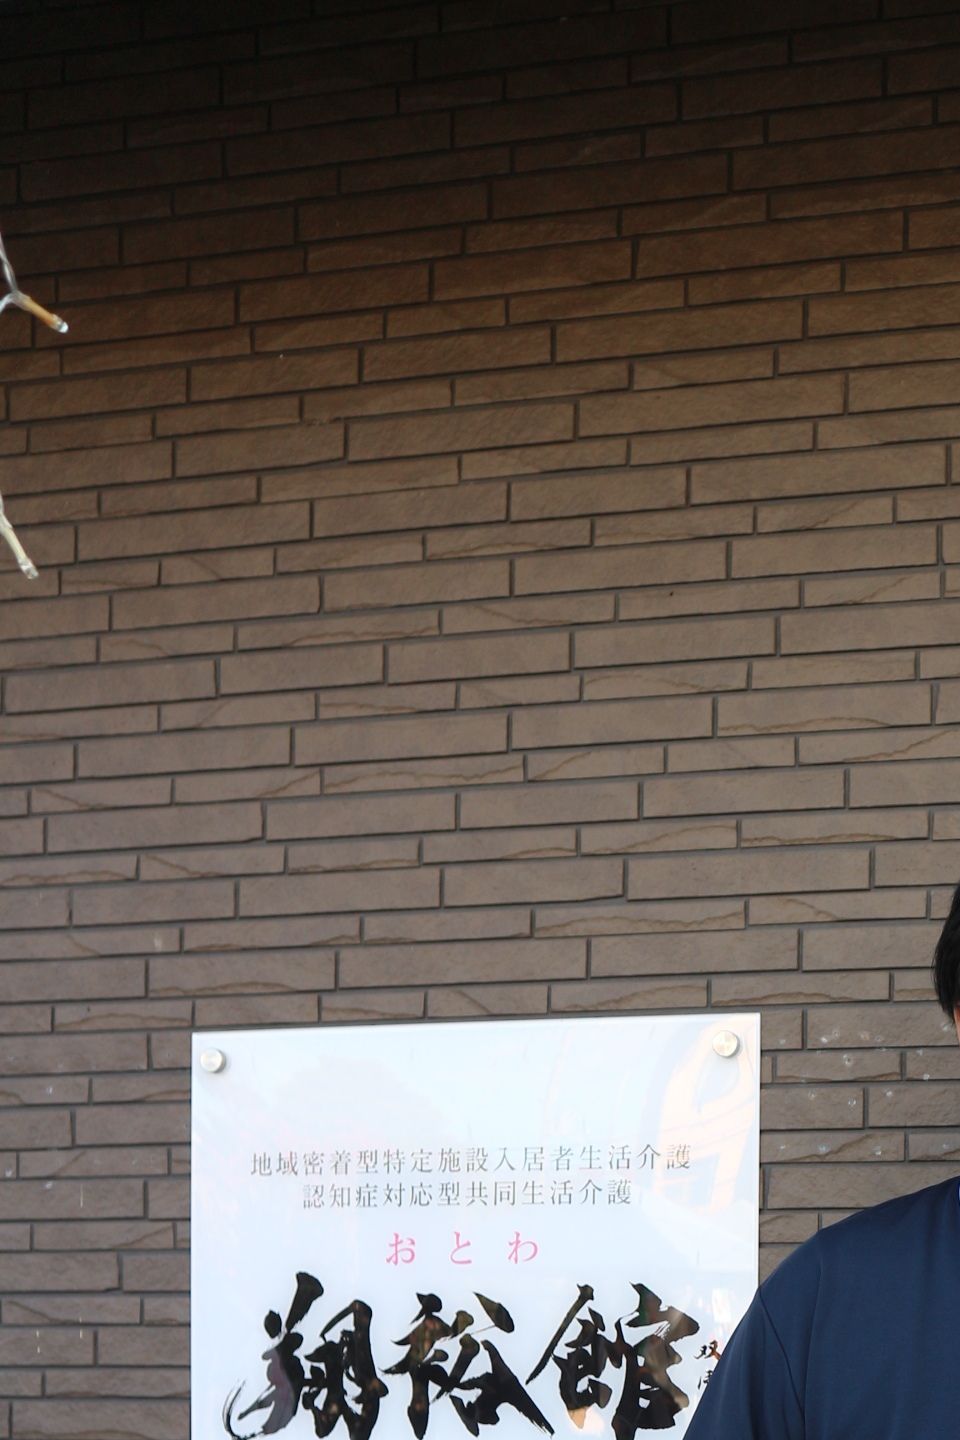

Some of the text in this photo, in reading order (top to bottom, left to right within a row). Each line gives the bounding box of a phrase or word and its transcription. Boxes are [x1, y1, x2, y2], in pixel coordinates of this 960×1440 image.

[250, 1143, 691, 1177] 地域密着型特定施設入居者生活介護
[303, 1178, 632, 1208] 認知症対応型共同生活介護
[386, 1231, 538, 1265] おとわ
